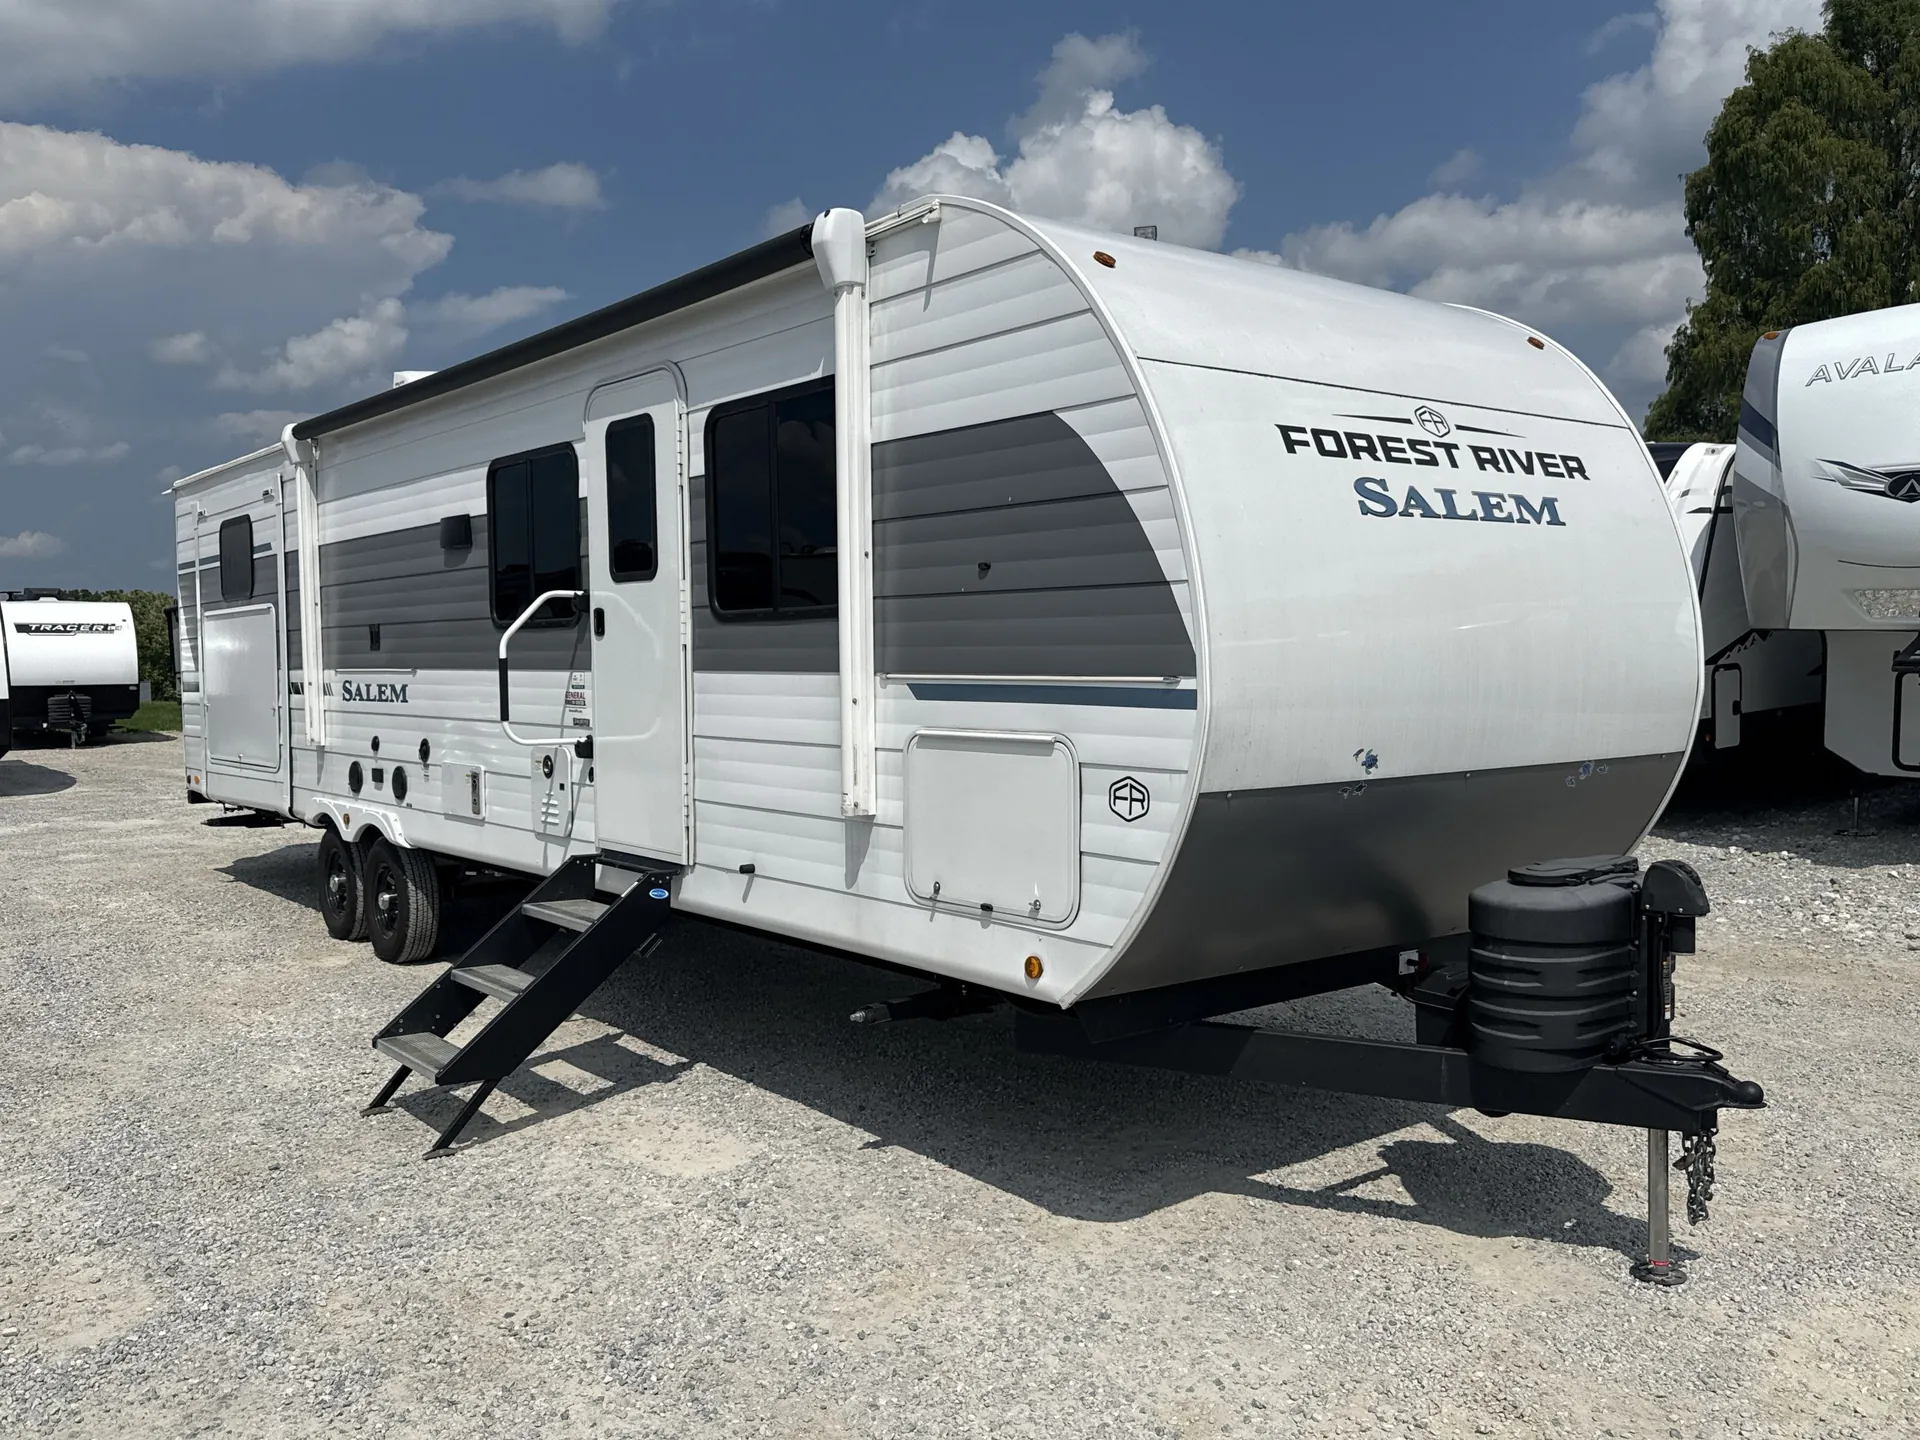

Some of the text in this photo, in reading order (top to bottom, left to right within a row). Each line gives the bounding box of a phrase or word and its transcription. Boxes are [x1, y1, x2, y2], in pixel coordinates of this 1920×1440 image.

[1274, 424, 1591, 481] FOREST RIVER
[1353, 476, 1567, 526] SALEM
[342, 679, 409, 703] SALEM
